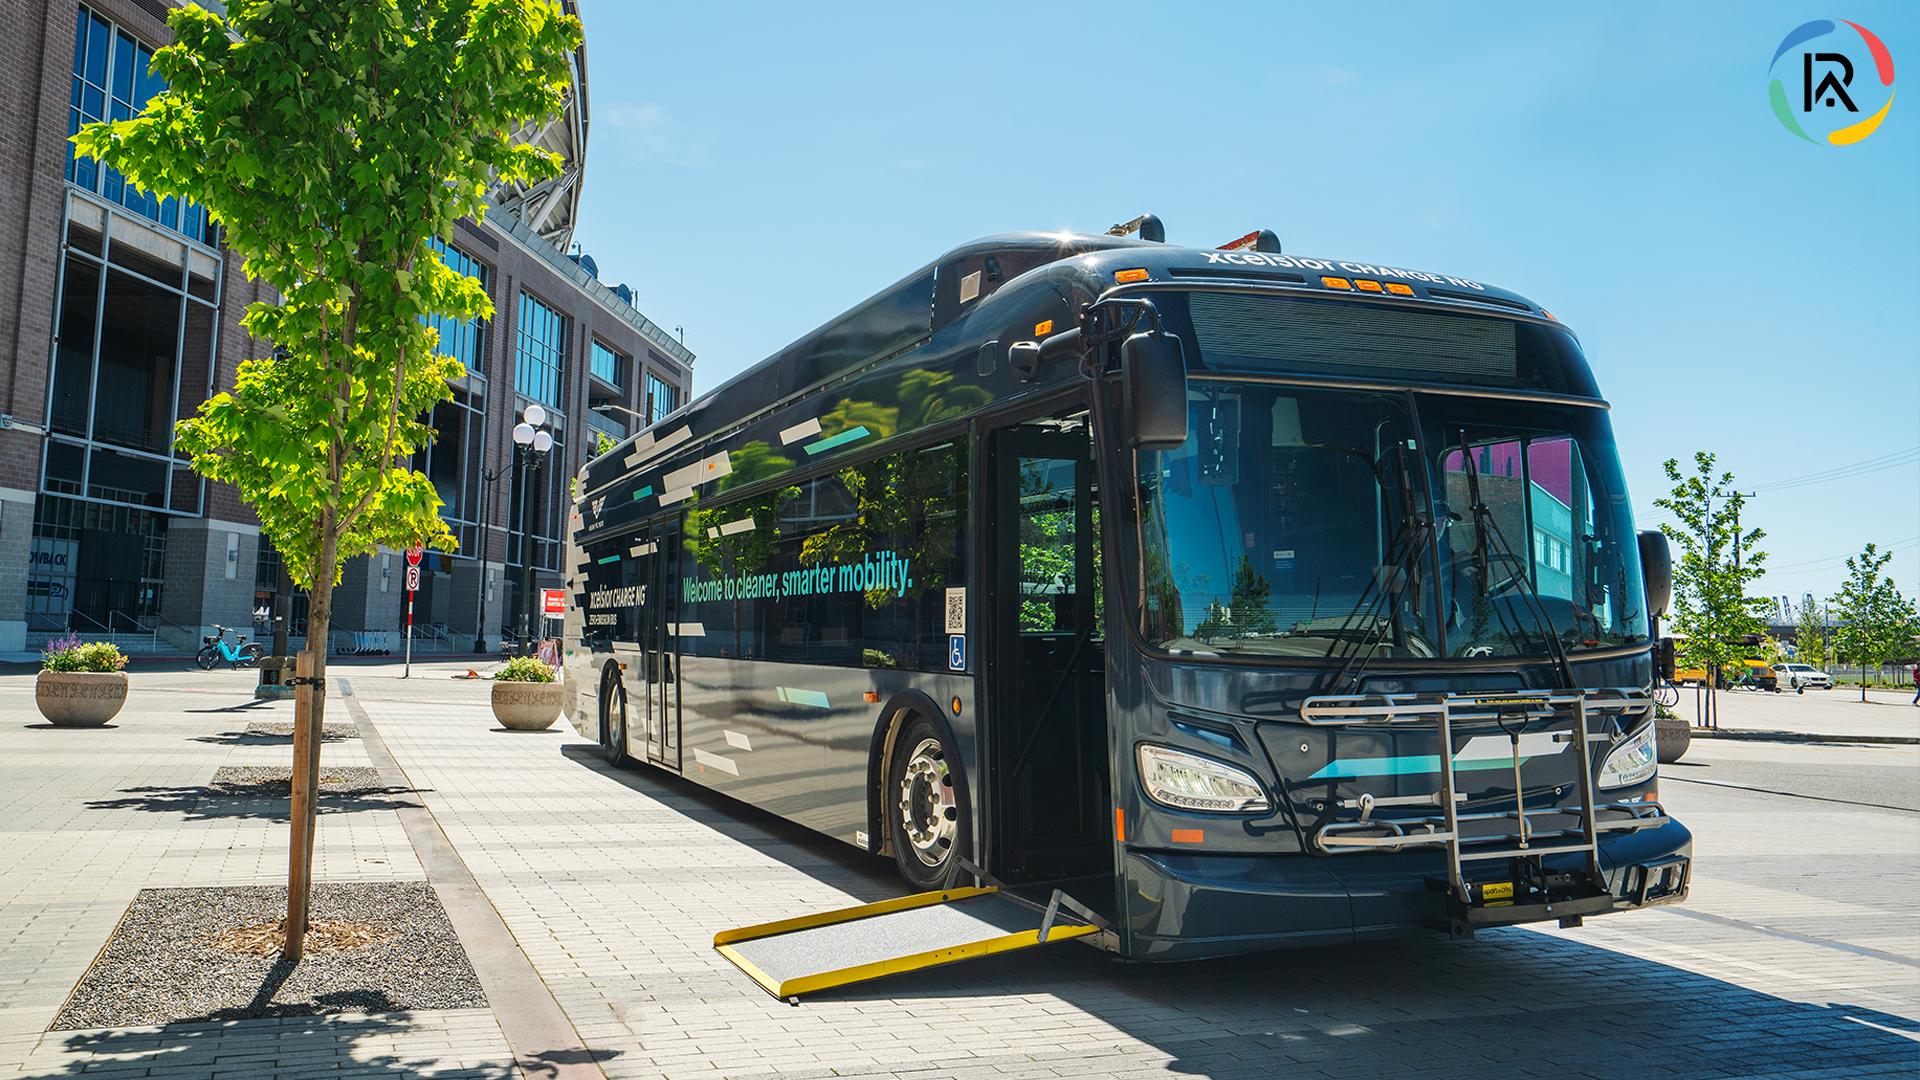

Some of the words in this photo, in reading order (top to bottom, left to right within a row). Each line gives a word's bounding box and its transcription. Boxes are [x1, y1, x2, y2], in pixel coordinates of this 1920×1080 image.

[1339, 261, 1445, 284] CHARGE
[1443, 275, 1485, 291] NG
[683, 576, 722, 603] Welcome
[725, 573, 735, 600] to
[736, 570, 780, 603] cleaner,
[782, 562, 836, 597] smarter
[839, 550, 913, 597] mobility.
[612, 585, 636, 608] CHARGE
